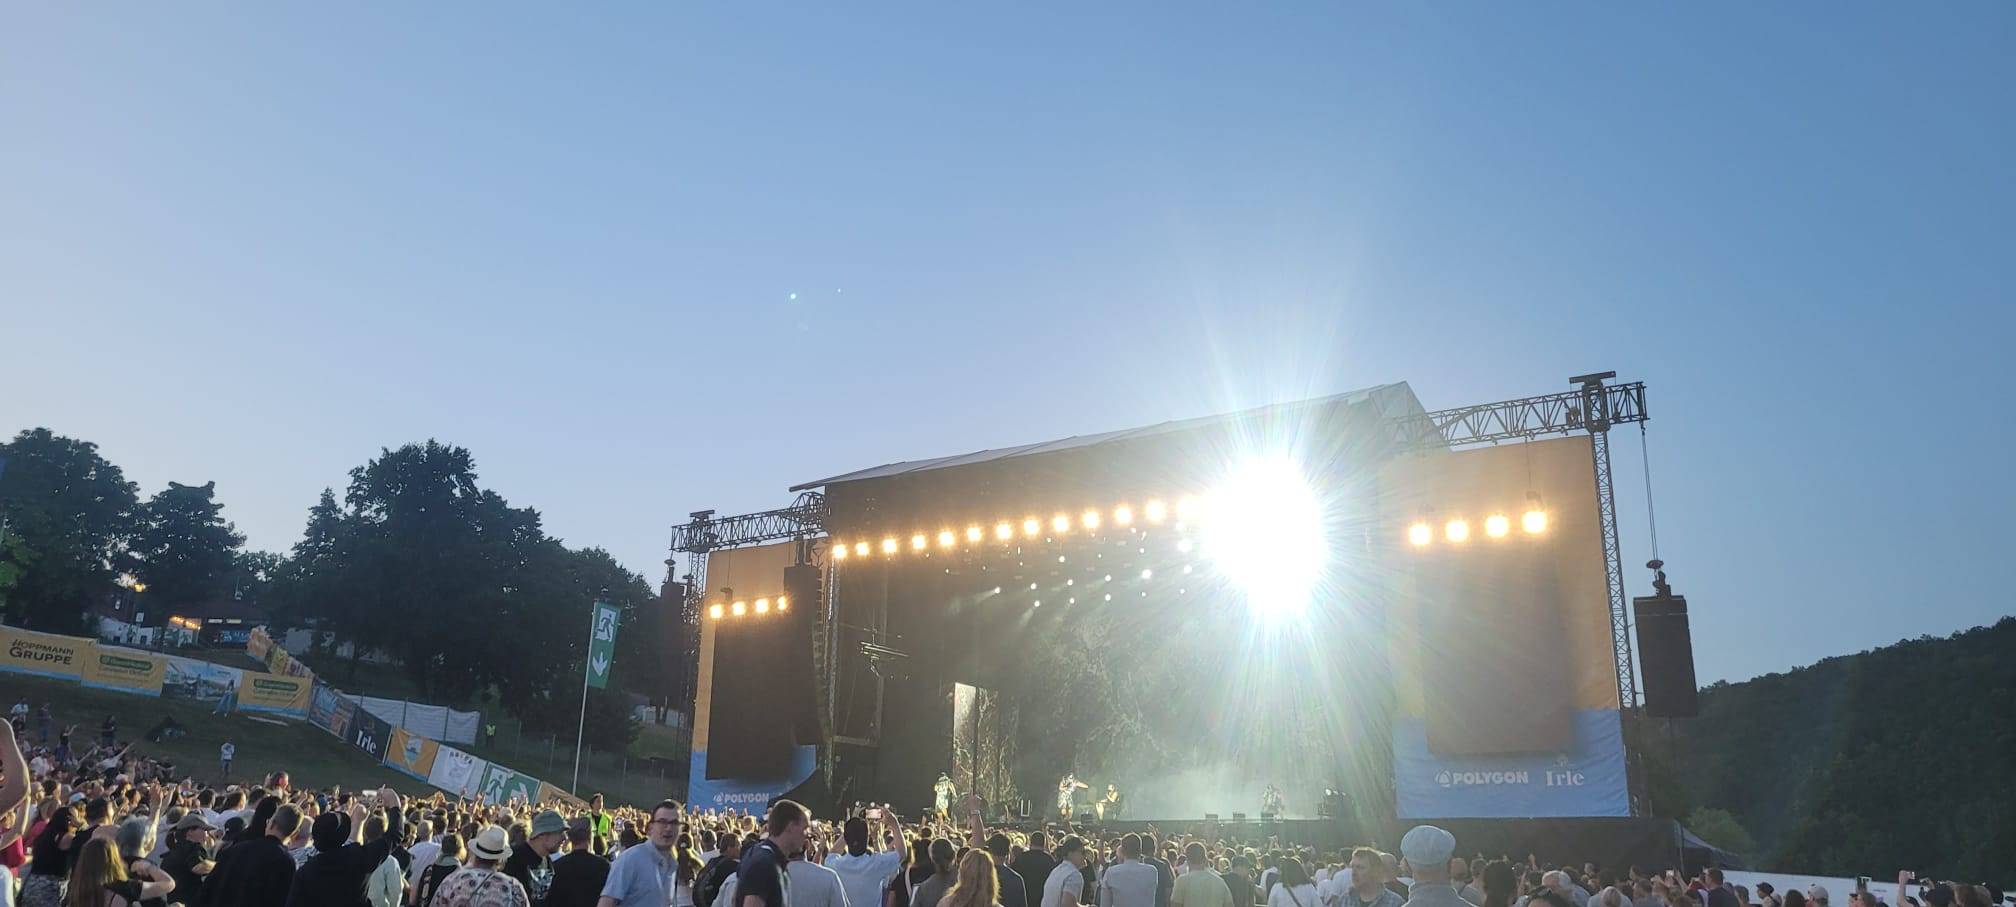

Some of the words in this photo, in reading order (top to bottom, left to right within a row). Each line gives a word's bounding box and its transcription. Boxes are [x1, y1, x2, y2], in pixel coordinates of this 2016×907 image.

[12, 639, 74, 655] HOPPMANN
[9, 646, 73, 665] GRUPPE
[356, 729, 377, 754] Irle
[1453, 770, 1529, 785] POLYGON
[1546, 770, 1585, 786] Irle
[725, 792, 770, 804] POLYGON
